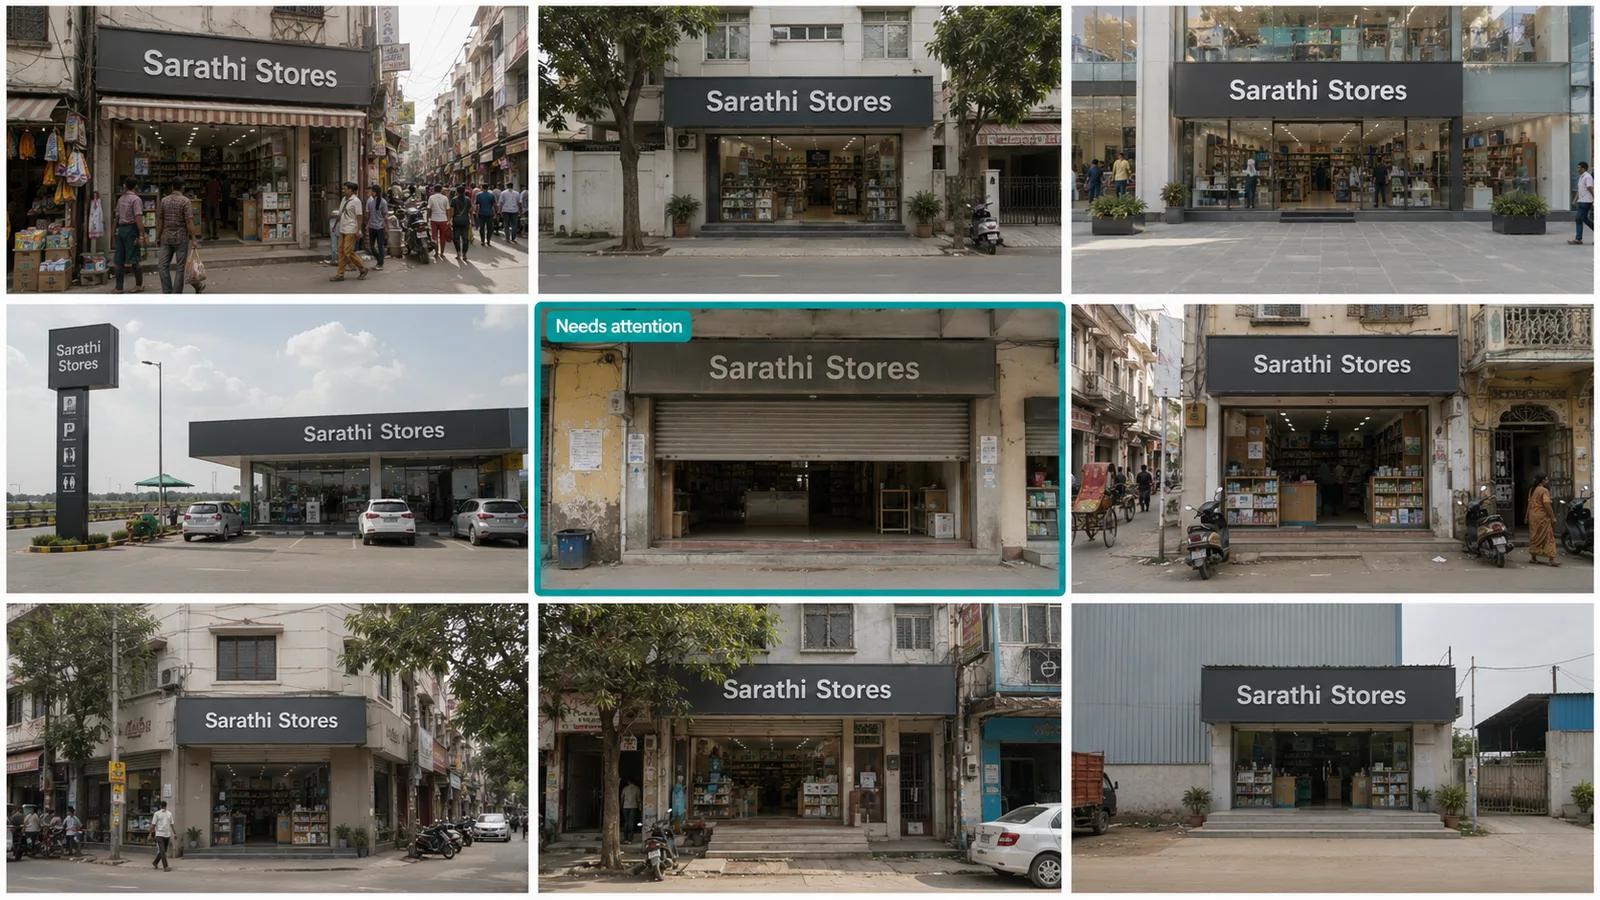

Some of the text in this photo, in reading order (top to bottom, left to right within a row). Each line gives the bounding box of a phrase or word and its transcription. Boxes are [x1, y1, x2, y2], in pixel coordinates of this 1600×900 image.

[143, 49, 338, 88] Sarathi Stores
[1229, 78, 1408, 101] Sarathi Stores
[706, 89, 892, 112] Sarathi Stores
[56, 340, 101, 357] Sarathi
[58, 358, 99, 373] Stores
[709, 354, 920, 380] Sarathi Stores
[1253, 354, 1412, 374] Sarathi Stores
[63, 422, 76, 438] P
[303, 422, 445, 442] Sarathi Stores
[723, 678, 892, 699] Sarathi Stores
[1236, 684, 1407, 705] Sarathi Stores
[205, 711, 338, 729] Sarathi Stores
